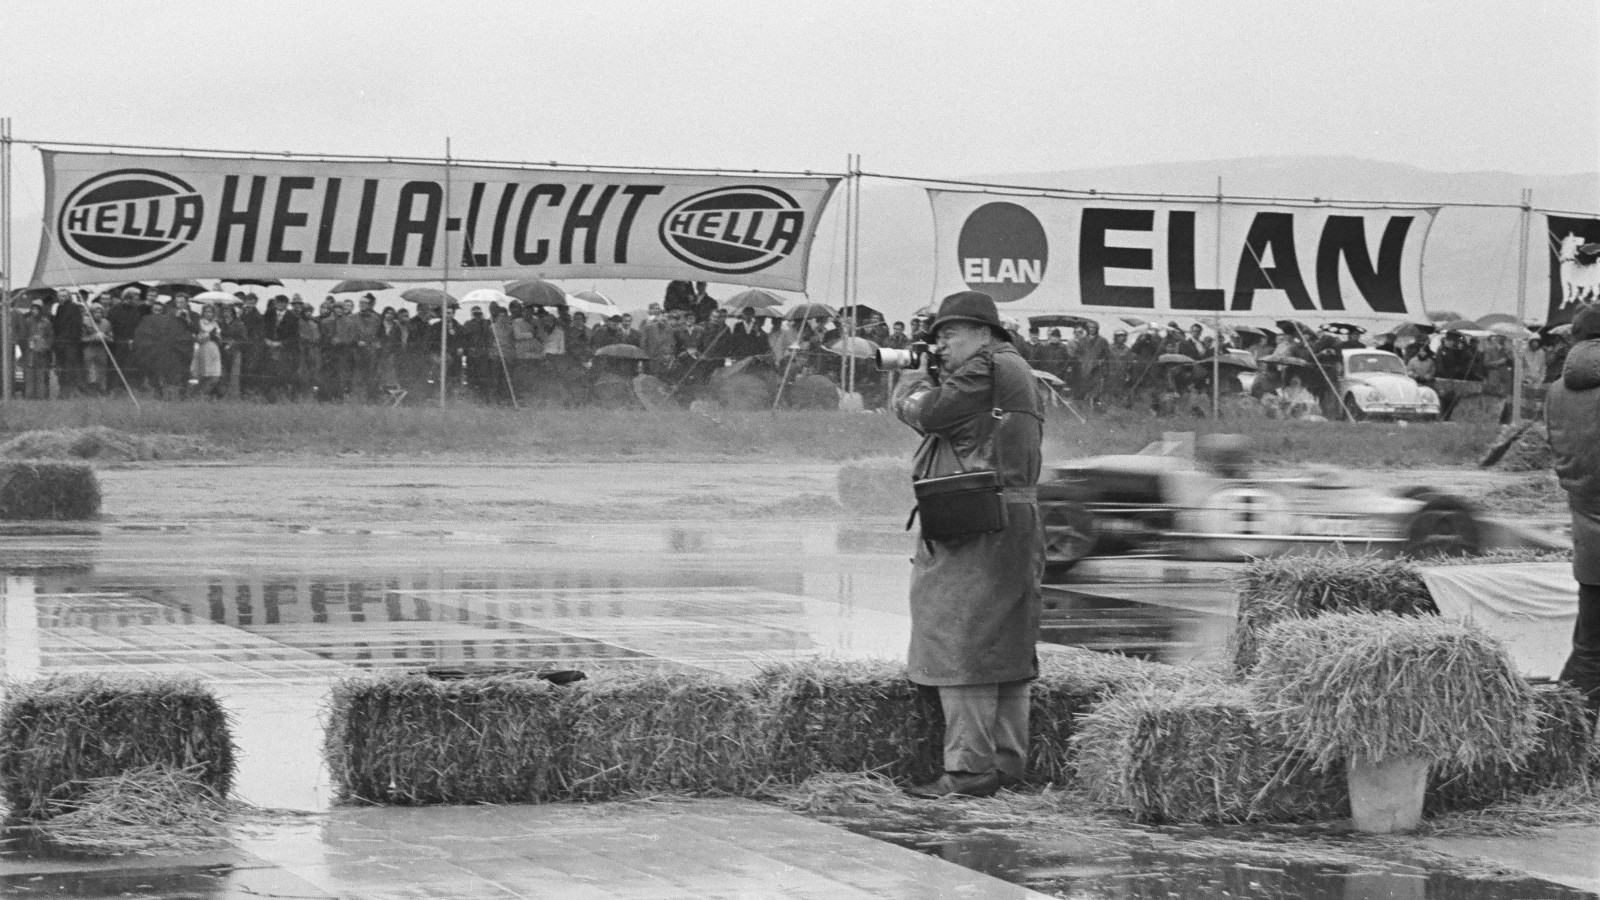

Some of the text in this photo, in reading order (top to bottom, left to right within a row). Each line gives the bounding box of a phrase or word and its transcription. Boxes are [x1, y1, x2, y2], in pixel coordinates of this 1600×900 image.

[67, 194, 203, 242] HELLA
[212, 174, 666, 268] HELLA-LICHT
[669, 210, 804, 256] HELLA
[964, 256, 1043, 285] ELAN
[1078, 207, 1416, 315] ELAN
